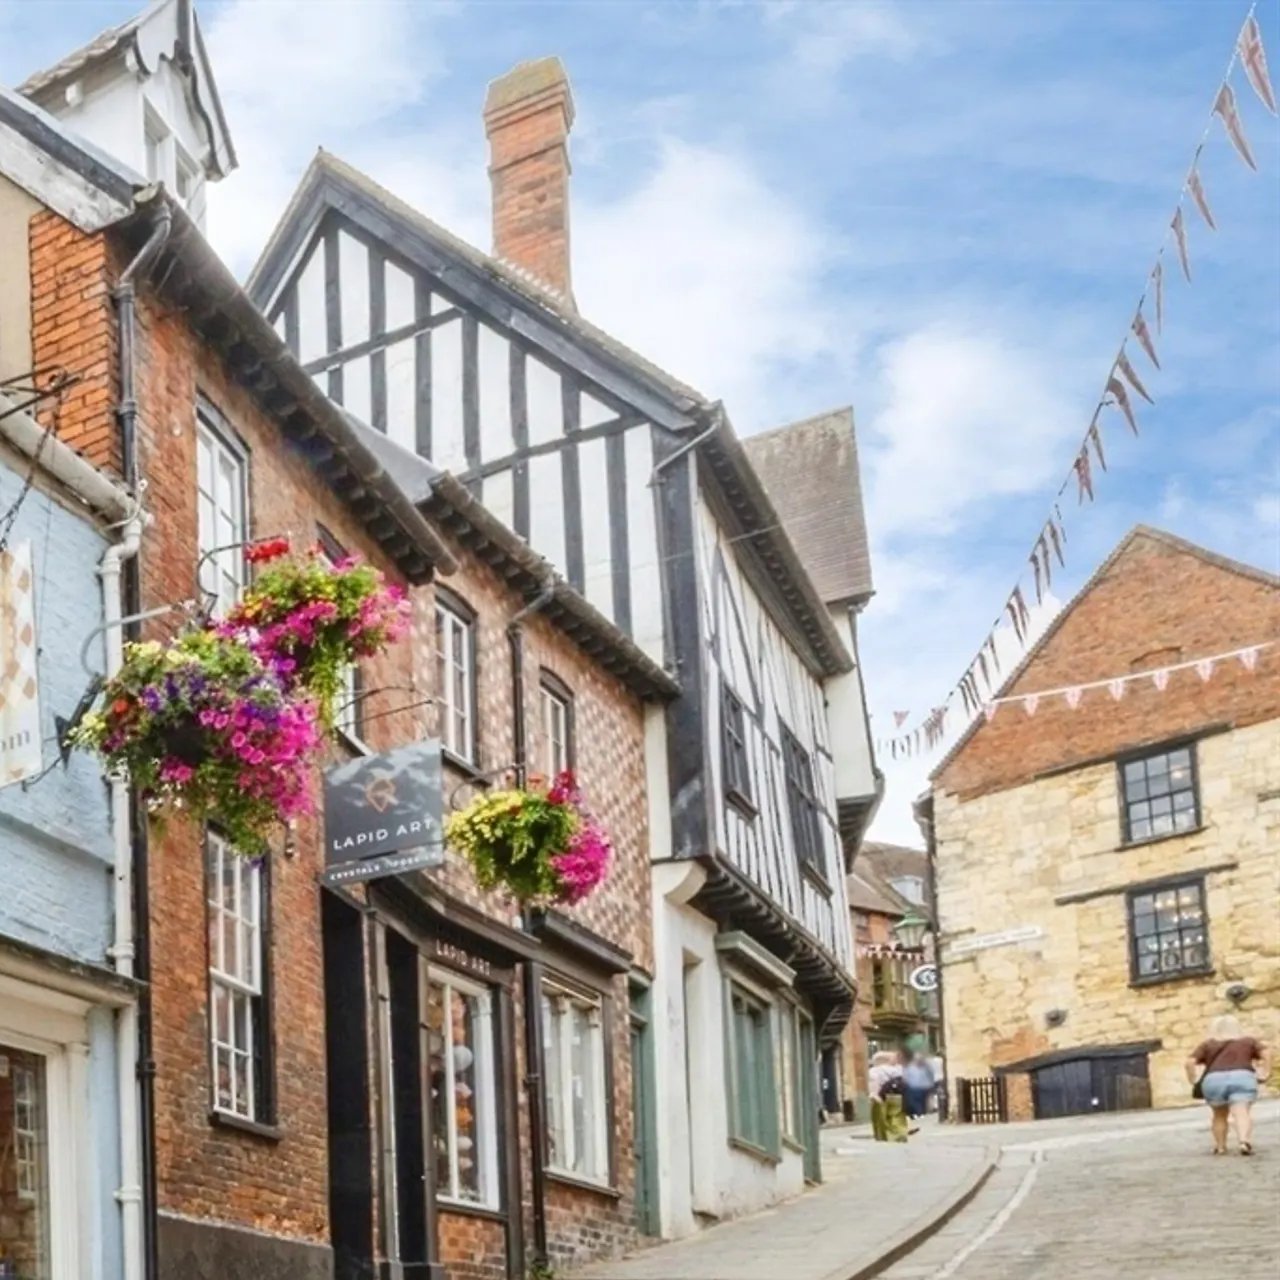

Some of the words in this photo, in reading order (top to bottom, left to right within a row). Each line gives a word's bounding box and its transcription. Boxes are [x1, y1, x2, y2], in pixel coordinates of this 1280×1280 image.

[333, 828, 389, 850] LAPID
[396, 816, 433, 836] ART
[436, 938, 468, 967] LAPID
[471, 956, 490, 976] ART
